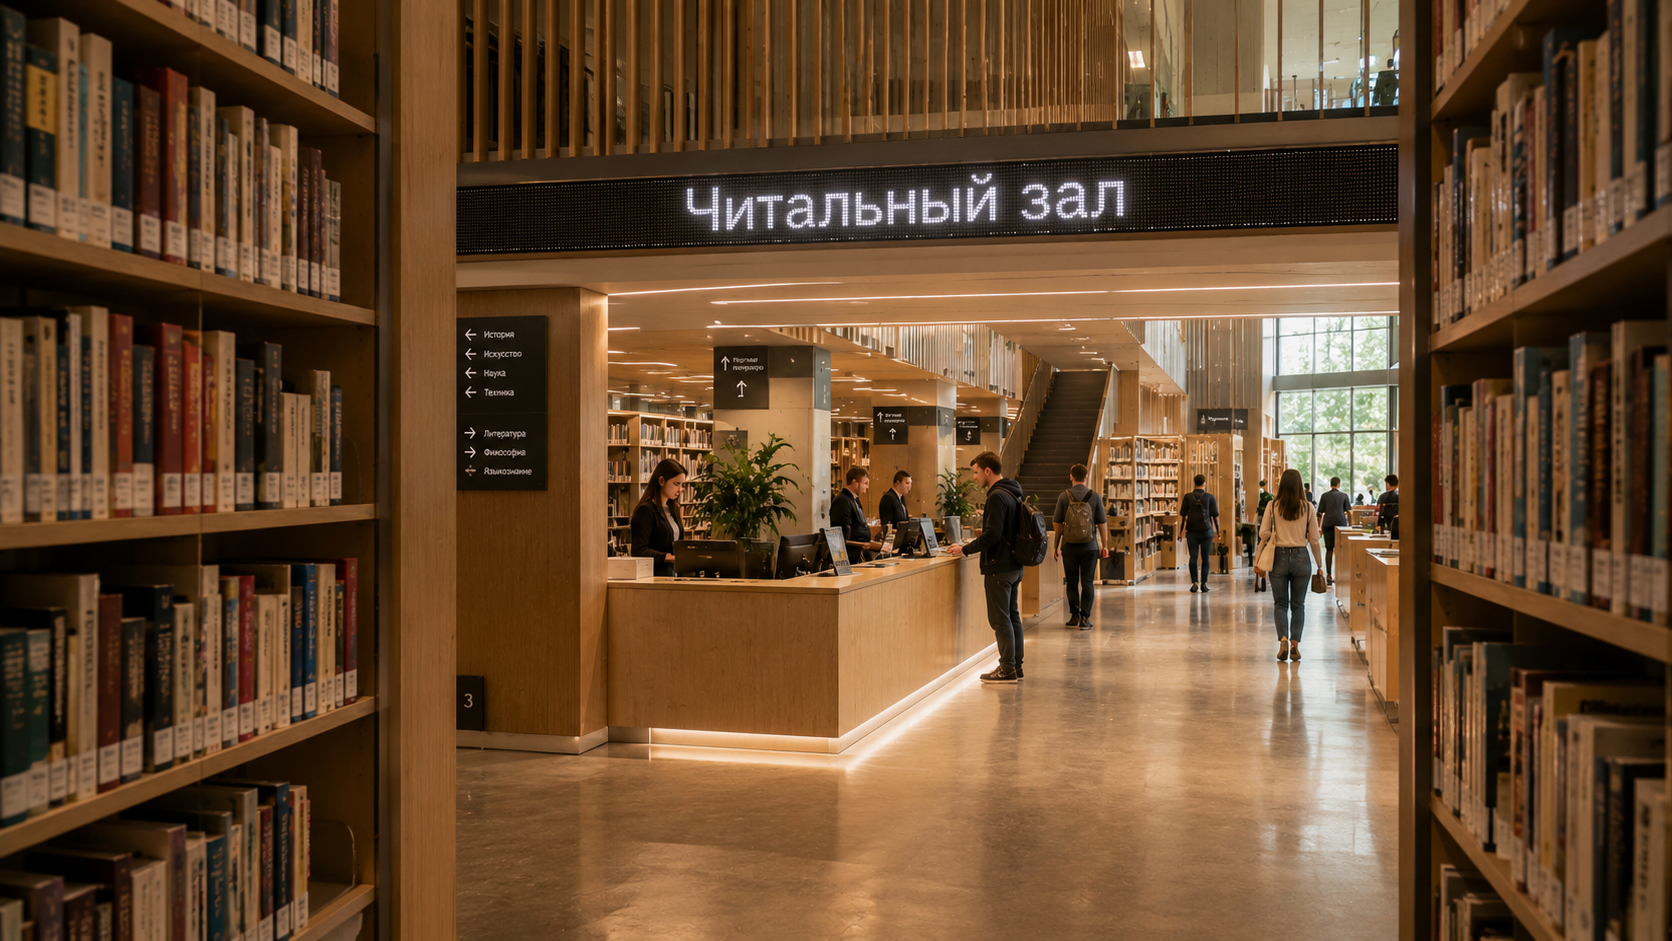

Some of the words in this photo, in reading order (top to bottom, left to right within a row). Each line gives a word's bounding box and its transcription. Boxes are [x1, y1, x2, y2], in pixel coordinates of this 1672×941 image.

[686, 172, 997, 231] Читальный
[1021, 180, 1125, 220] зал
[484, 330, 514, 339] История
[484, 350, 522, 359] Искусство
[484, 369, 506, 378] Наука
[483, 429, 526, 439] Литература
[463, 693, 474, 709] 3
